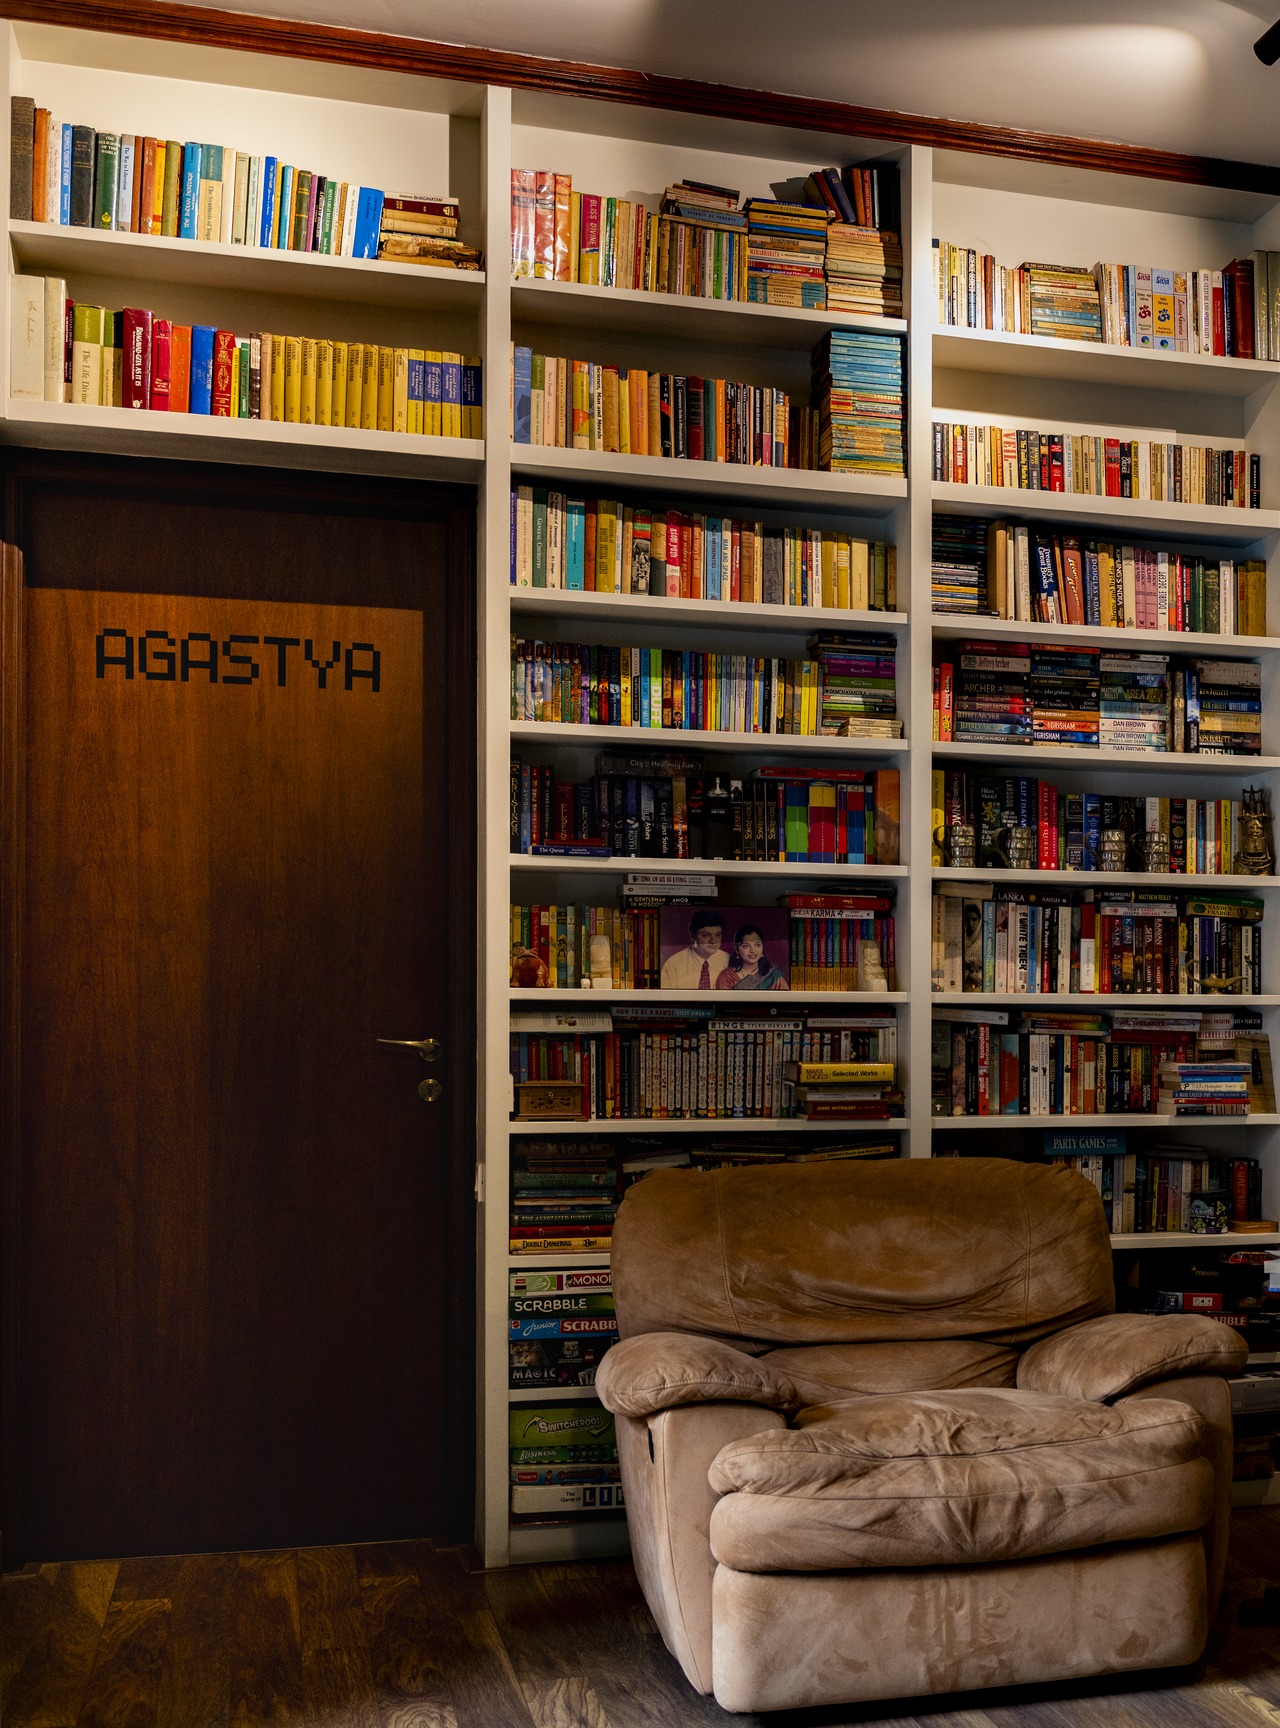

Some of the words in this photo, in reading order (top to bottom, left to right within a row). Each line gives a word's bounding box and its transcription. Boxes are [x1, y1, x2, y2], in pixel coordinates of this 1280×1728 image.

[1003, 431, 1017, 462] VEIL
[95, 628, 381, 692] AGASTYA
[963, 684, 997, 693] ARCHER
[1050, 722, 1075, 730] GRISHAM
[1037, 731, 1060, 740] GRISHAM
[630, 760, 643, 769] City
[651, 760, 681, 770] Heavenly
[980, 787, 995, 795] Hilary
[511, 777, 519, 836] BRISINGR
[998, 892, 1025, 902] LANKA
[810, 909, 836, 918] KARMA
[1018, 944, 1027, 971] TIGER
[1053, 1137, 1077, 1149] PARTY
[1079, 1137, 1106, 1149] GAMES
[523, 1240, 543, 1249] DOUBLE
[543, 1239, 572, 1248] DANGEROUS
[514, 1298, 588, 1313] SCRABBLE
[520, 1449, 557, 1461] BUSINESS
